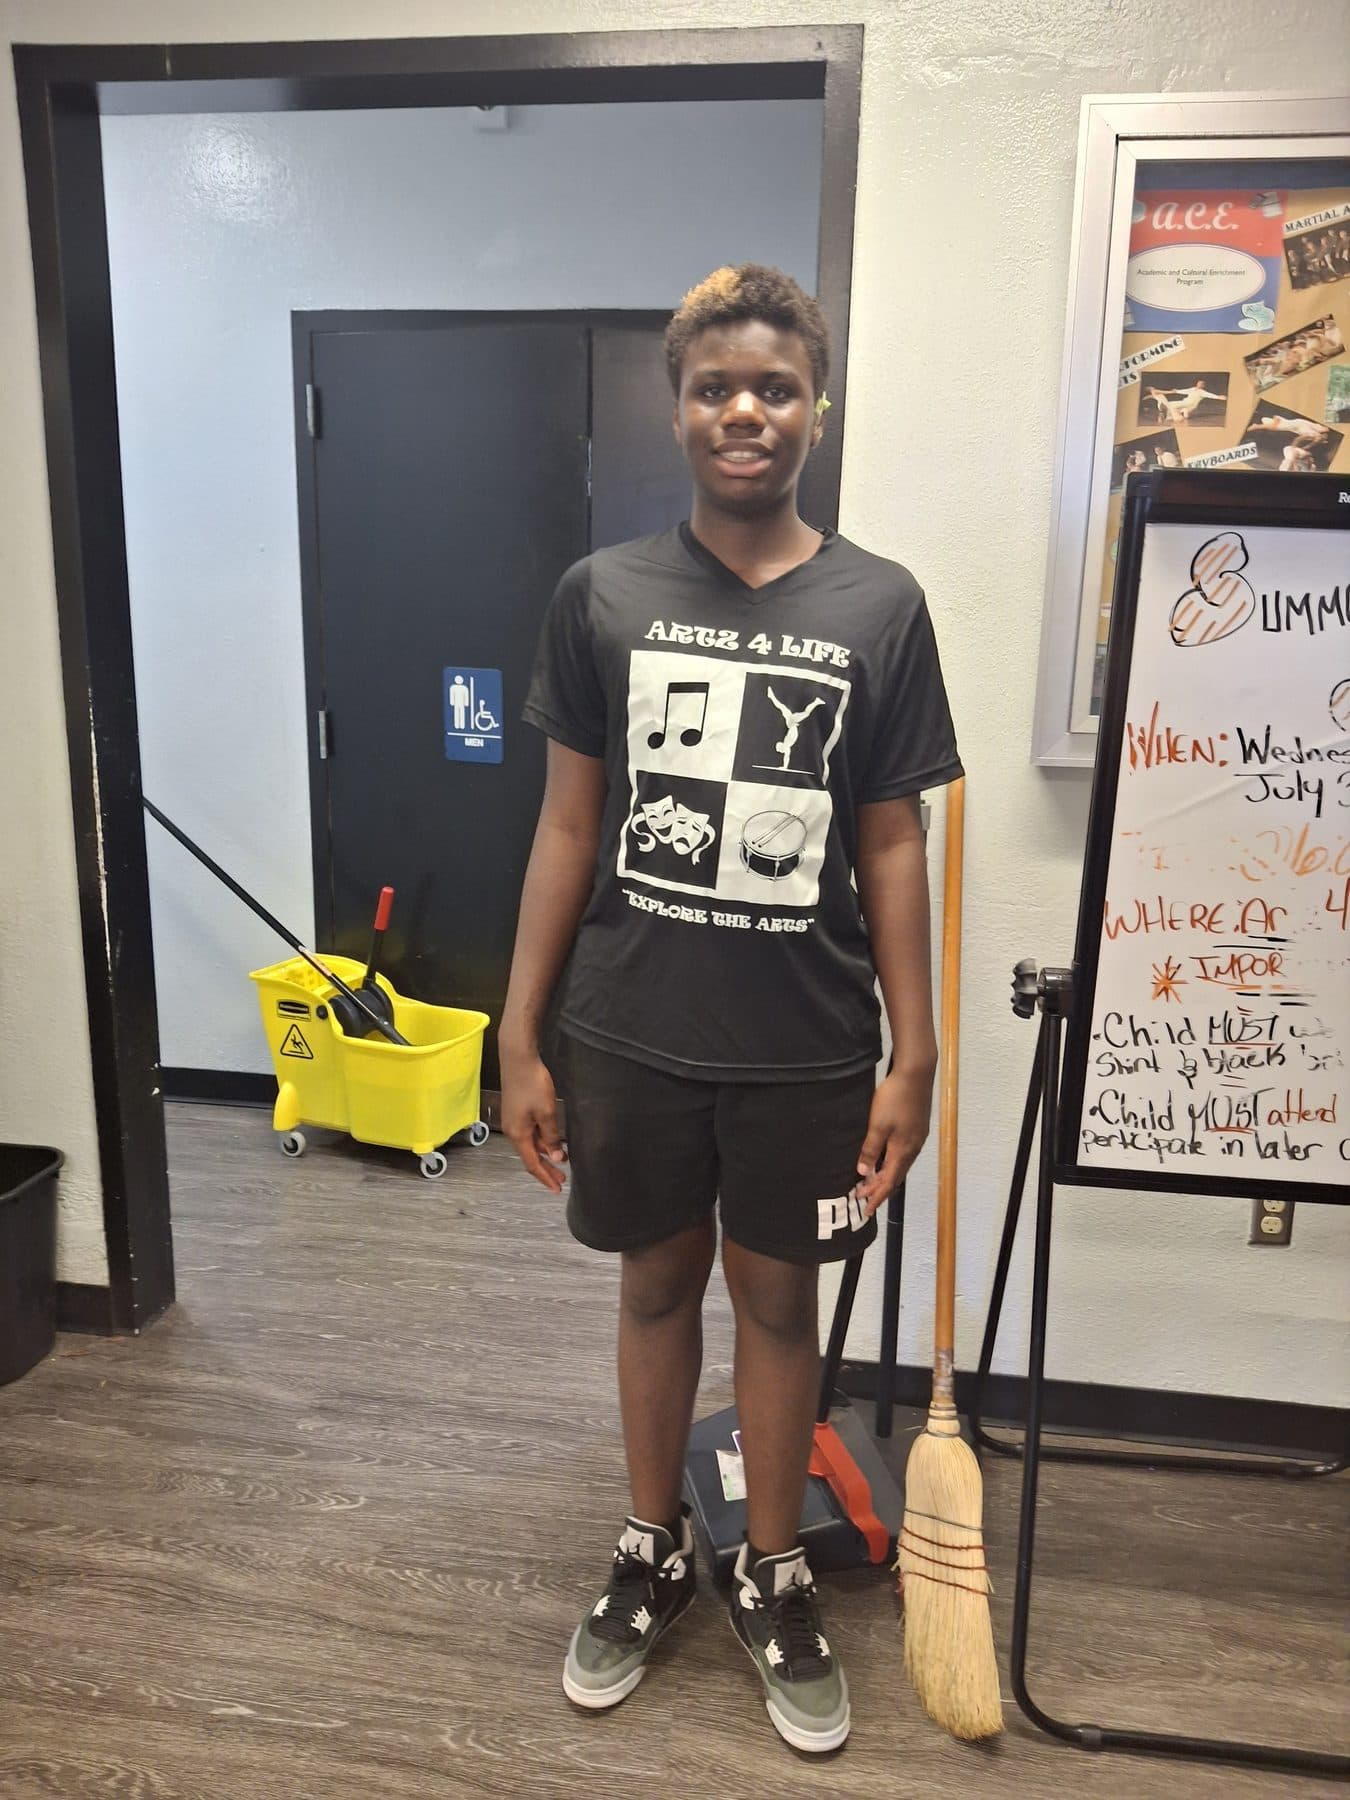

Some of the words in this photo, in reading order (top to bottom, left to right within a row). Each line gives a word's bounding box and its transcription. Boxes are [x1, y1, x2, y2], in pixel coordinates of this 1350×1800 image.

[1284, 209, 1339, 232] MARTIAL
[747, 633, 772, 655] 4
[780, 634, 851, 668] LIFE
[464, 737, 484, 747] MEN
[1127, 701, 1228, 770] WHEN:
[1234, 769, 1324, 818] July
[711, 911, 751, 929] THE
[1209, 1010, 1279, 1044] MUST
[1099, 1089, 1174, 1131] Child
[1188, 1088, 1275, 1132] MUST
[1220, 1136, 1244, 1157] in
[1255, 1130, 1322, 1161] later
